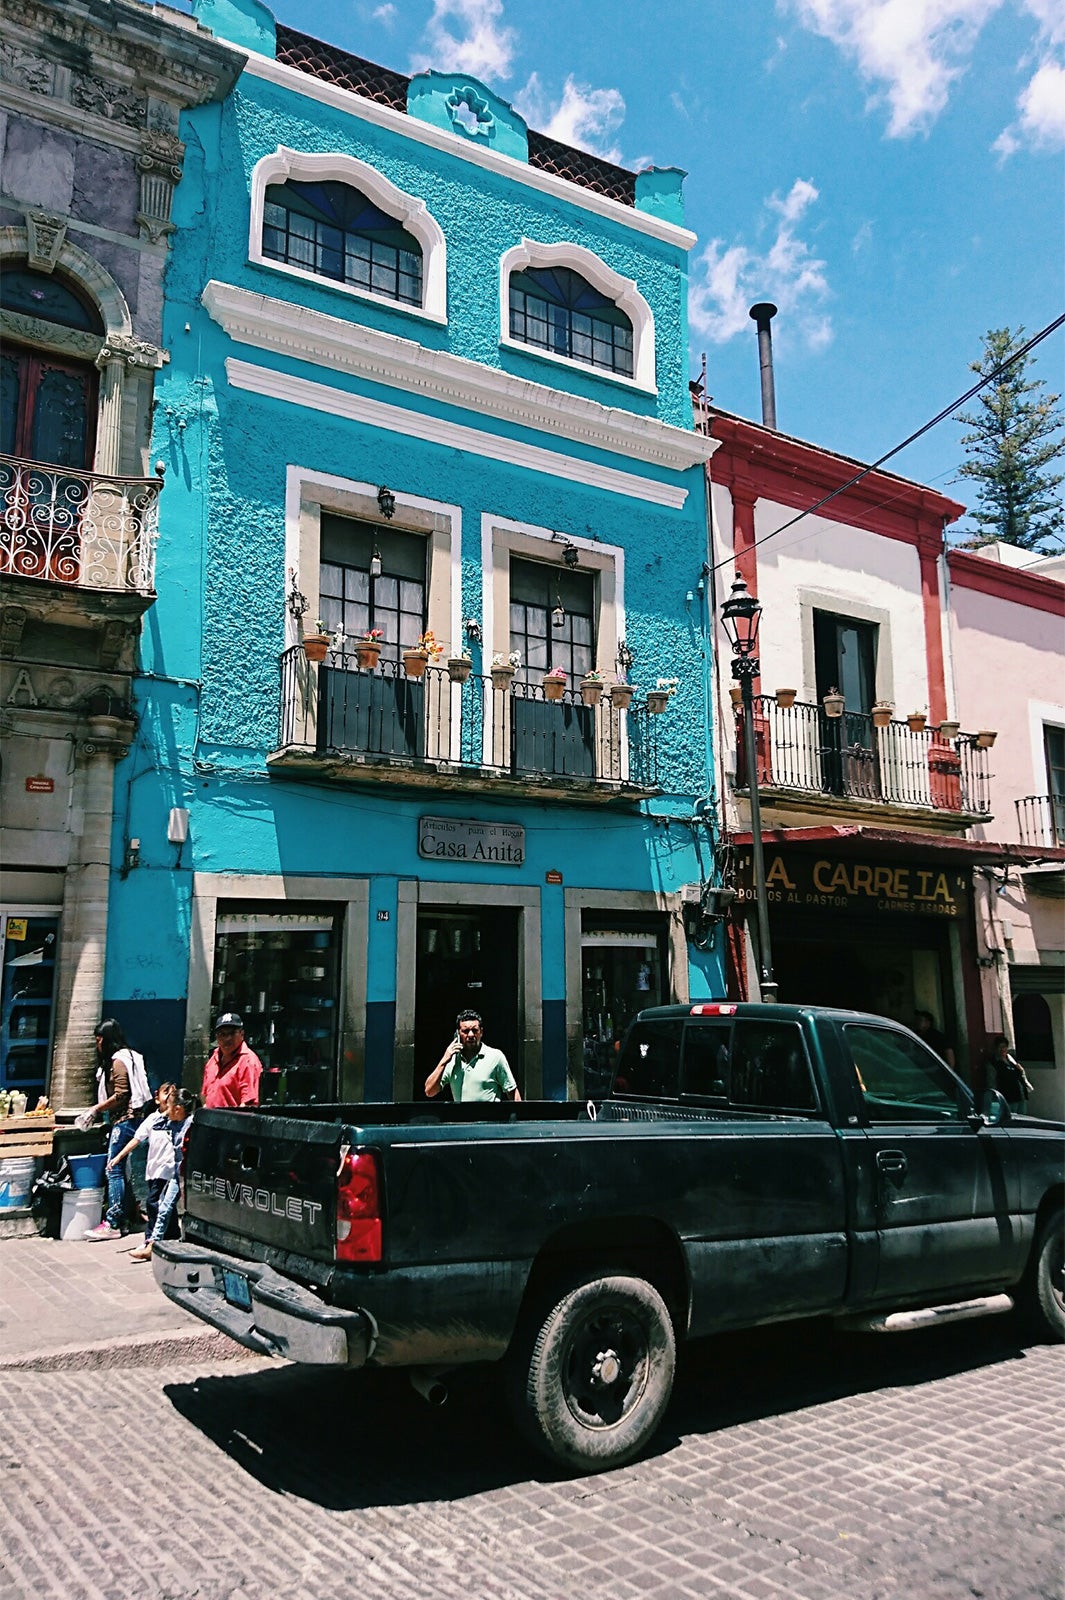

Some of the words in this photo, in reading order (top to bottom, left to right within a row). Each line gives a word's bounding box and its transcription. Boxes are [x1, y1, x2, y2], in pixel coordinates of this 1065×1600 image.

[468, 826, 484, 835] para
[489, 827, 497, 836] el
[502, 828, 524, 839] Hogar
[420, 835, 468, 858] Casa
[472, 840, 524, 862] Anita
[738, 888, 782, 902] POLOS
[787, 892, 802, 904] AL
[806, 894, 849, 907] PASTOR
[877, 900, 916, 912] CARNES
[919, 903, 958, 915] ASADAS
[219, 914, 259, 923] CASA
[378, 911, 389, 921] 94
[191, 1170, 323, 1226] CHEVROLET
